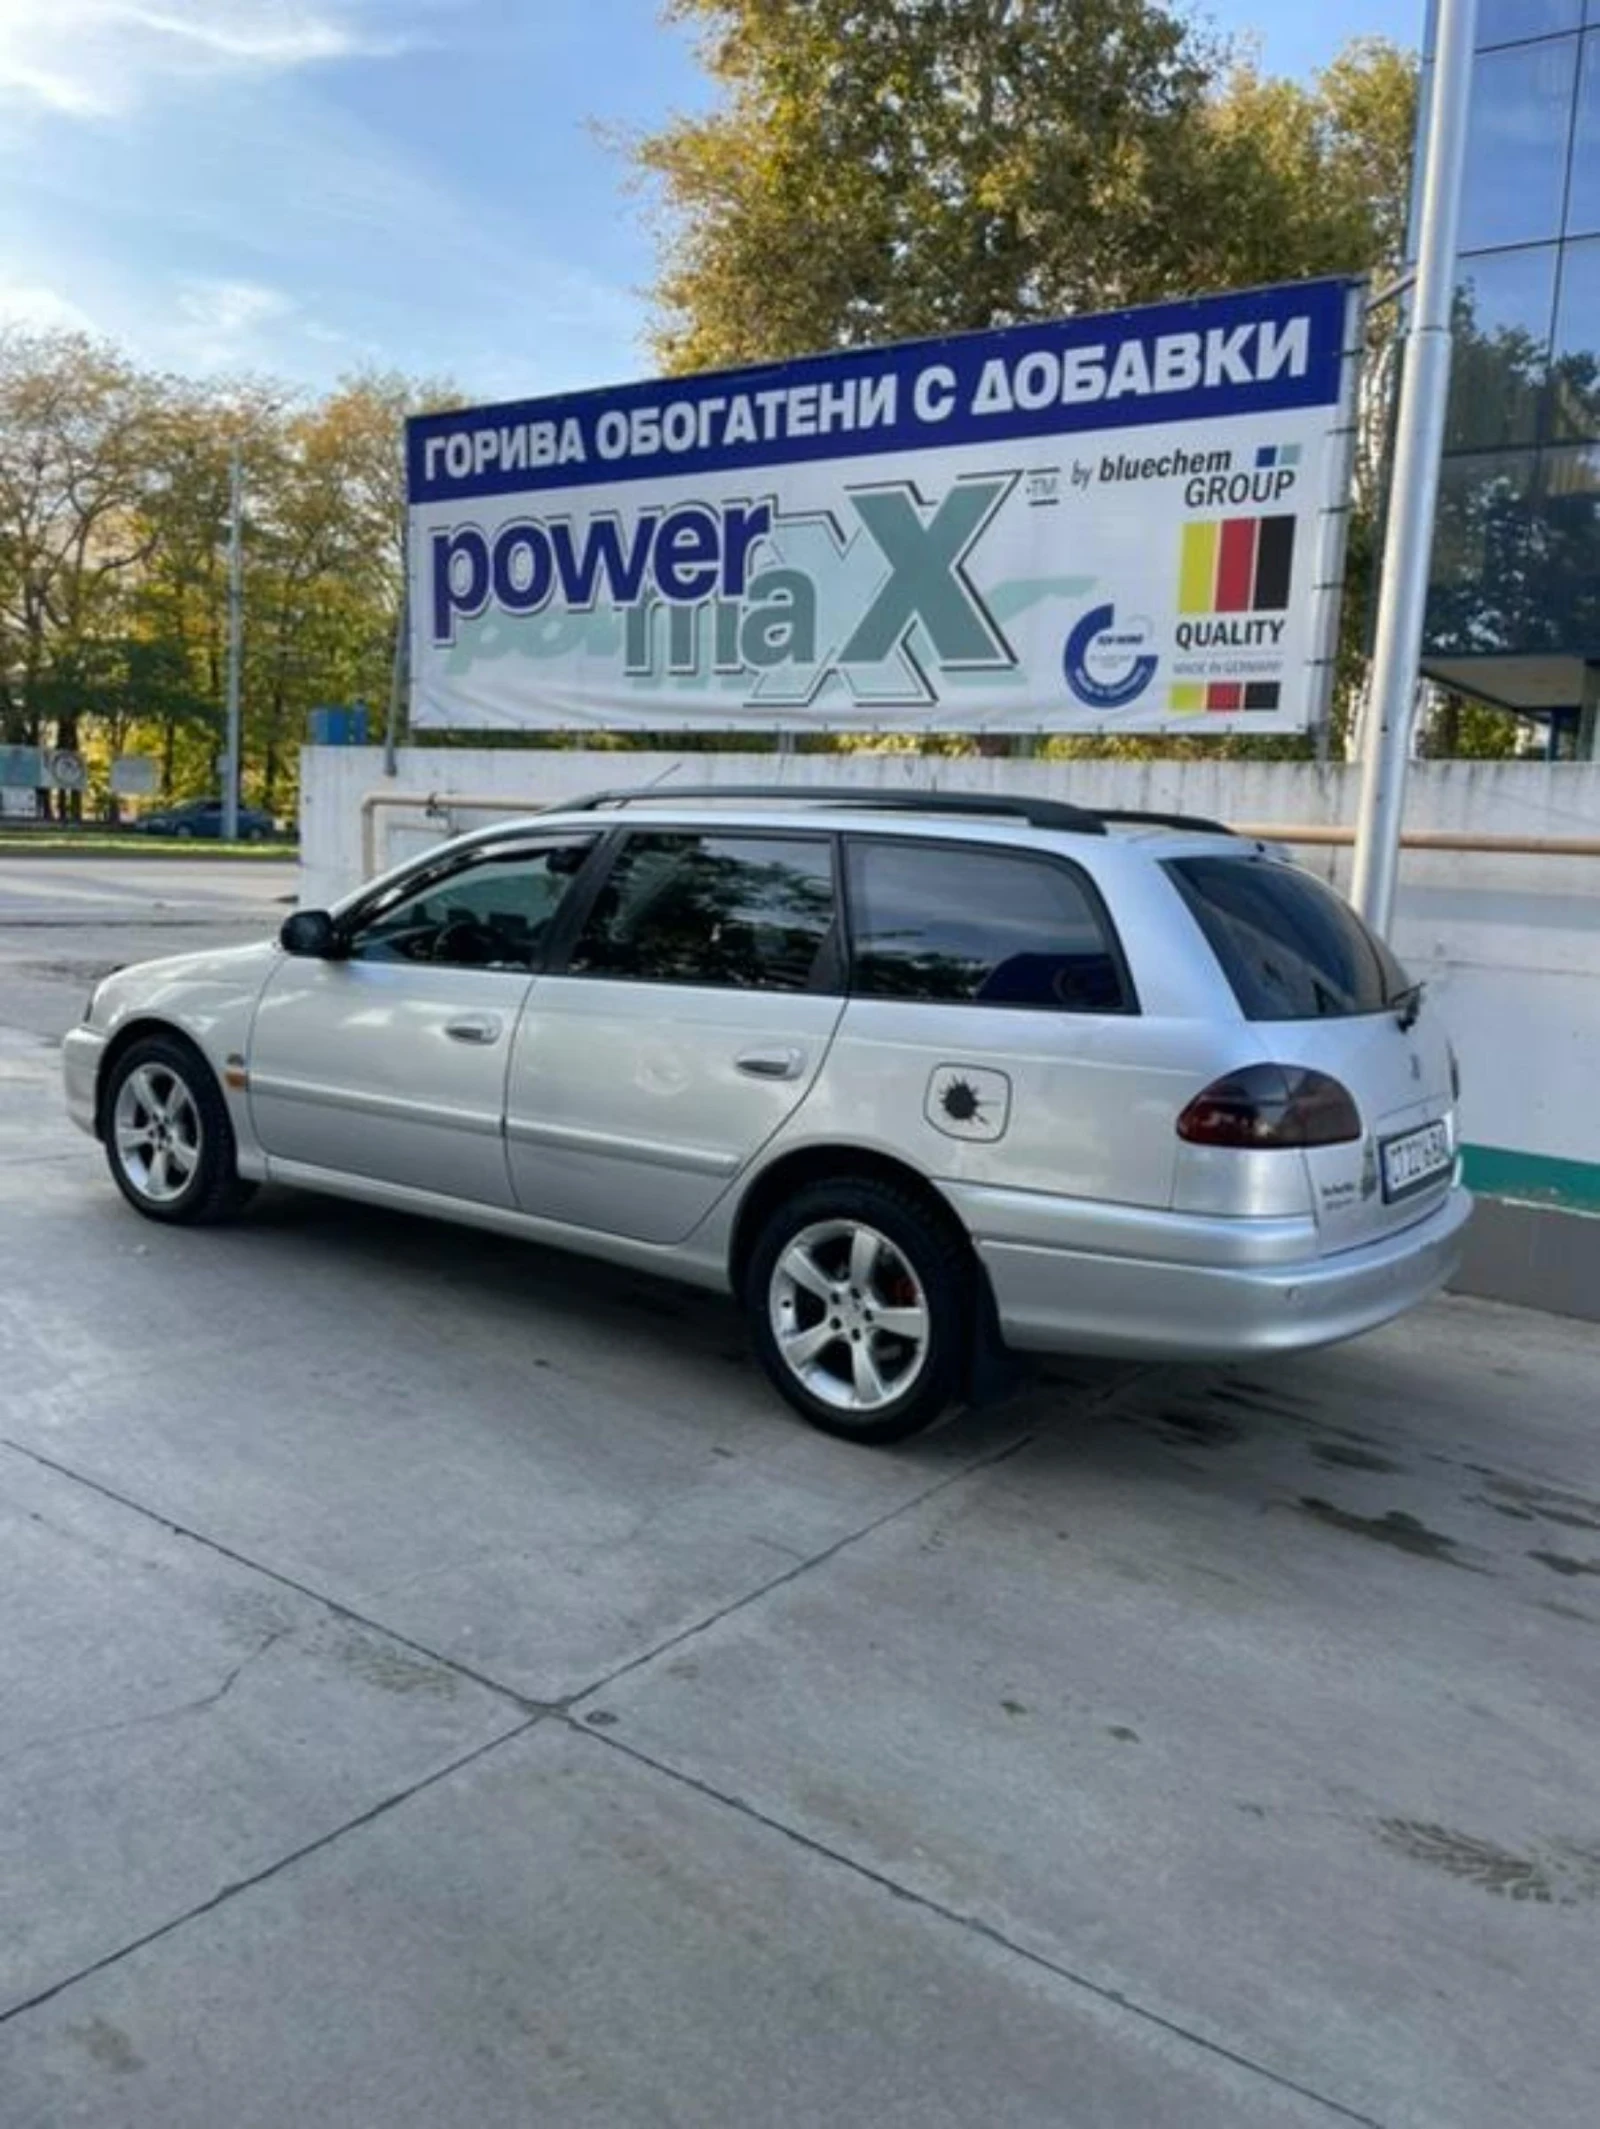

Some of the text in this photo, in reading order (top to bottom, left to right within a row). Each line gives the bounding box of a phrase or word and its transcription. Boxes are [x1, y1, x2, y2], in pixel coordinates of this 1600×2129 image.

[424, 317, 1310, 481] ГОРИВА ОБОГАТЕНИ С ДОБАВКИ
[1070, 448, 1232, 490] by bluechem
[1184, 470, 1295, 508] GROUP
[430, 498, 776, 646] power
[1175, 619, 1286, 650] QUALITY
